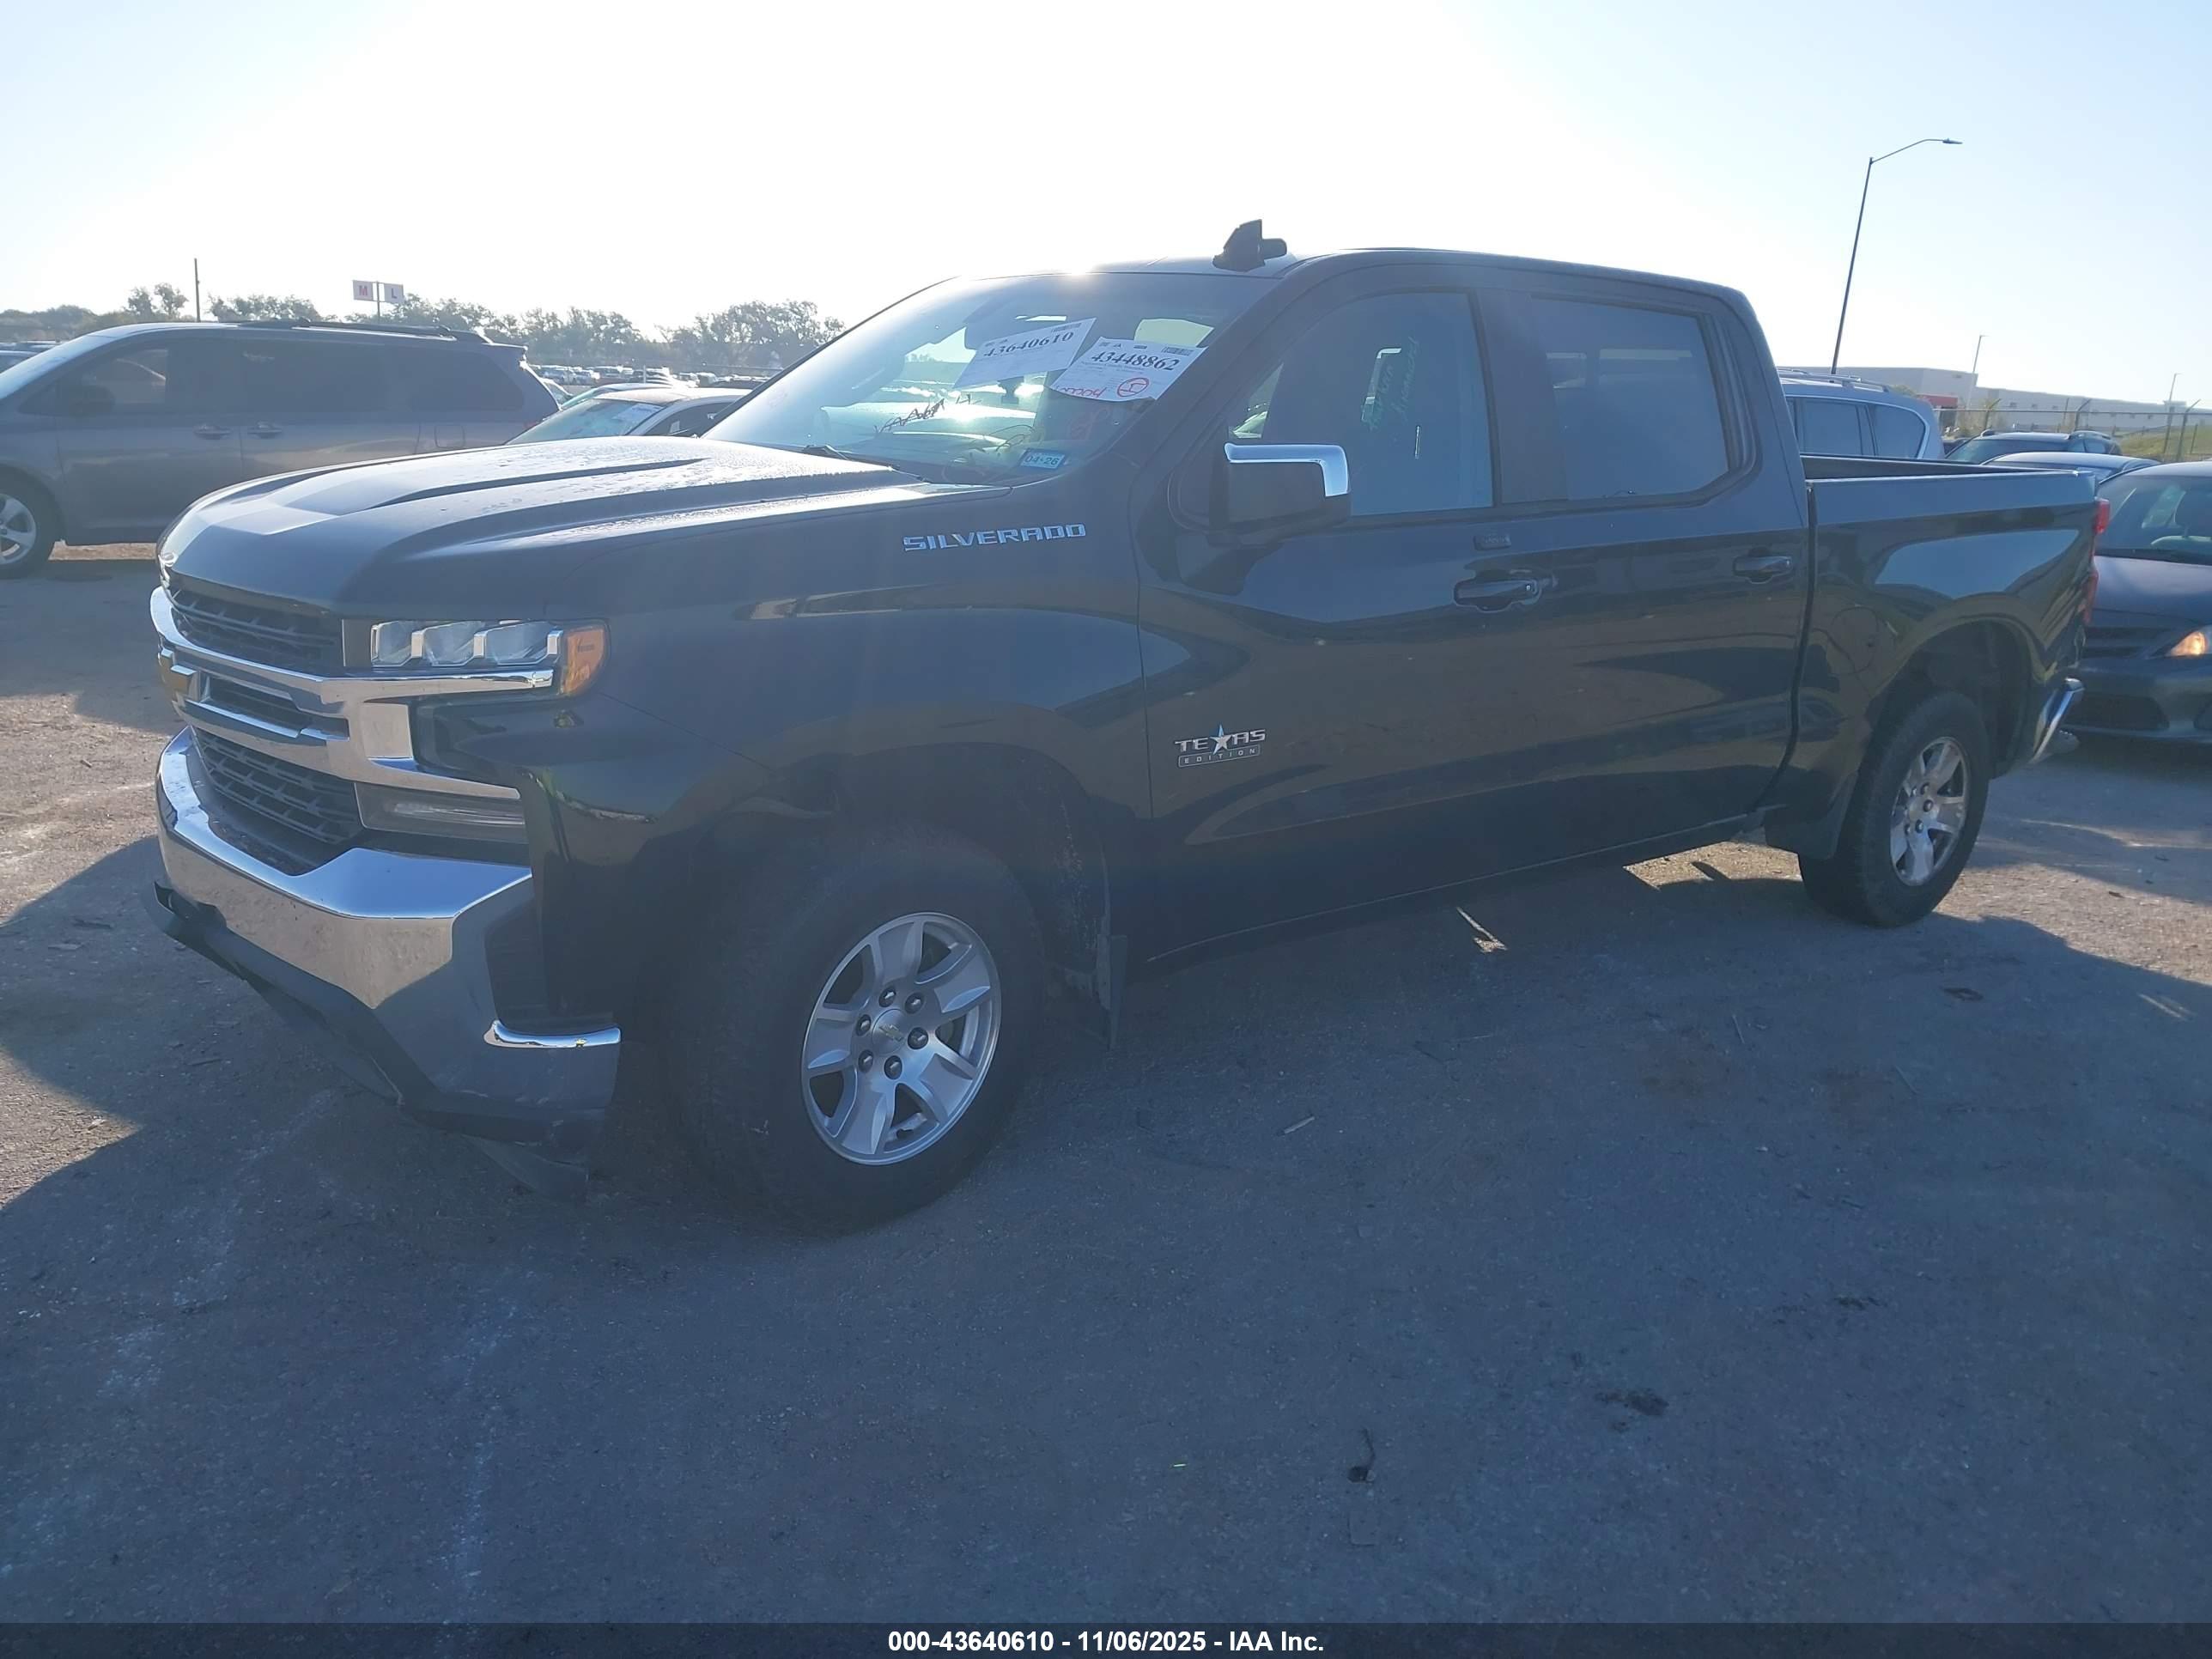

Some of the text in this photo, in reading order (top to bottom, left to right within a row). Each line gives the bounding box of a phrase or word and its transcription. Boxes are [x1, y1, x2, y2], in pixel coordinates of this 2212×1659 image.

[358, 285, 368, 296] M
[391, 288, 398, 299] L
[983, 331, 1074, 357] 43640610
[1091, 350, 1181, 371] 43448862
[902, 523, 1086, 552] SILVERADO
[1174, 724, 1266, 754] TEXAS
[1184, 748, 1256, 763] EDITION
